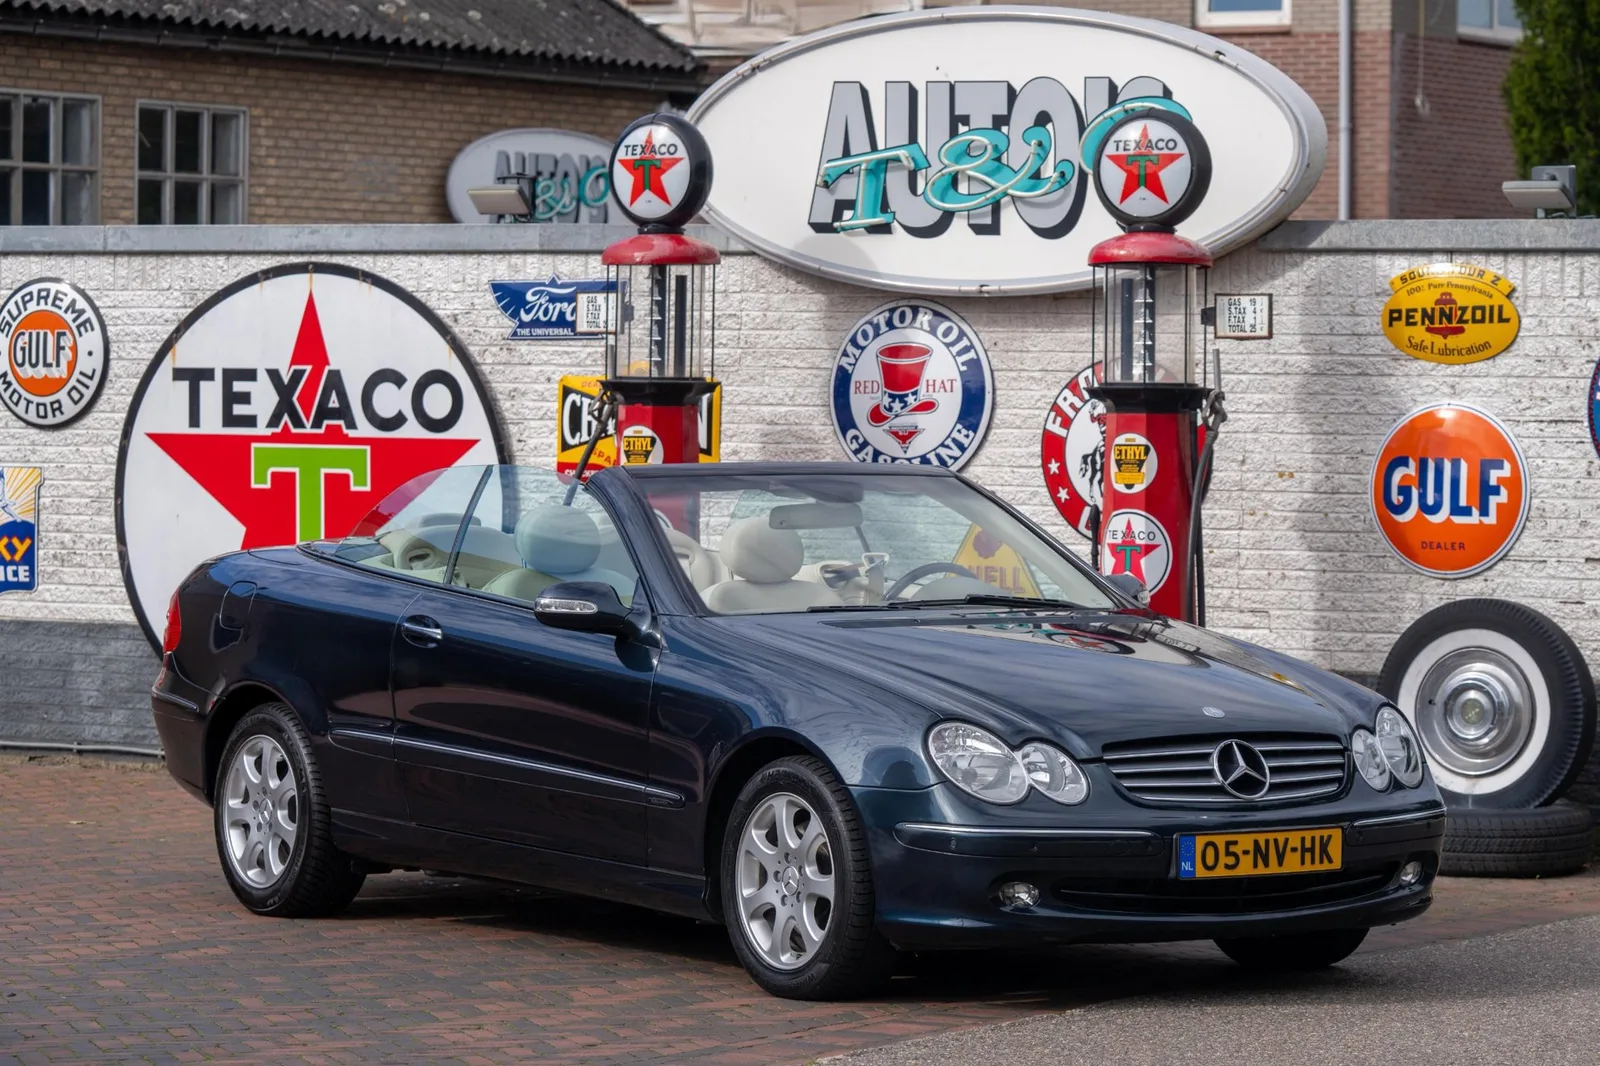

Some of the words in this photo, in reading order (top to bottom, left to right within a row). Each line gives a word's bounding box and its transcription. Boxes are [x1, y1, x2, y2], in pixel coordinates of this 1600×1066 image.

[624, 143, 679, 157] TEXACO
[1113, 138, 1178, 152] TEXACO
[808, 76, 1173, 239] AUTO'
[1490, 275, 1502, 286] Z
[1428, 282, 1445, 290] Pure
[1446, 281, 1494, 299] Pennsylvania
[1228, 298, 1242, 307] GAS
[0, 287, 95, 338] SUPREME
[1228, 307, 1247, 316] S.TAX
[1388, 304, 1512, 328] PENNZOIL
[516, 328, 531, 336] THE
[531, 328, 575, 336] UNIVERSAL
[1228, 325, 1248, 333] TOTAL
[838, 306, 934, 374] MOTOR
[936, 320, 980, 372] OIL
[1406, 335, 1429, 353] Safe
[1430, 340, 1493, 357] Lubrication
[13, 330, 70, 370] GULF
[0, 370, 64, 420] MOTOR
[66, 368, 97, 406] OIL
[854, 380, 880, 395] RED
[925, 379, 957, 394] HAT
[172, 367, 464, 434] TEXACO
[624, 437, 654, 451] ETHYL
[1114, 445, 1147, 460] ETHYL
[1382, 455, 1510, 524] GULF
[1420, 541, 1466, 551] DEALER
[1200, 834, 1334, 872] 05-NV-HK
[1181, 861, 1194, 871] NL
